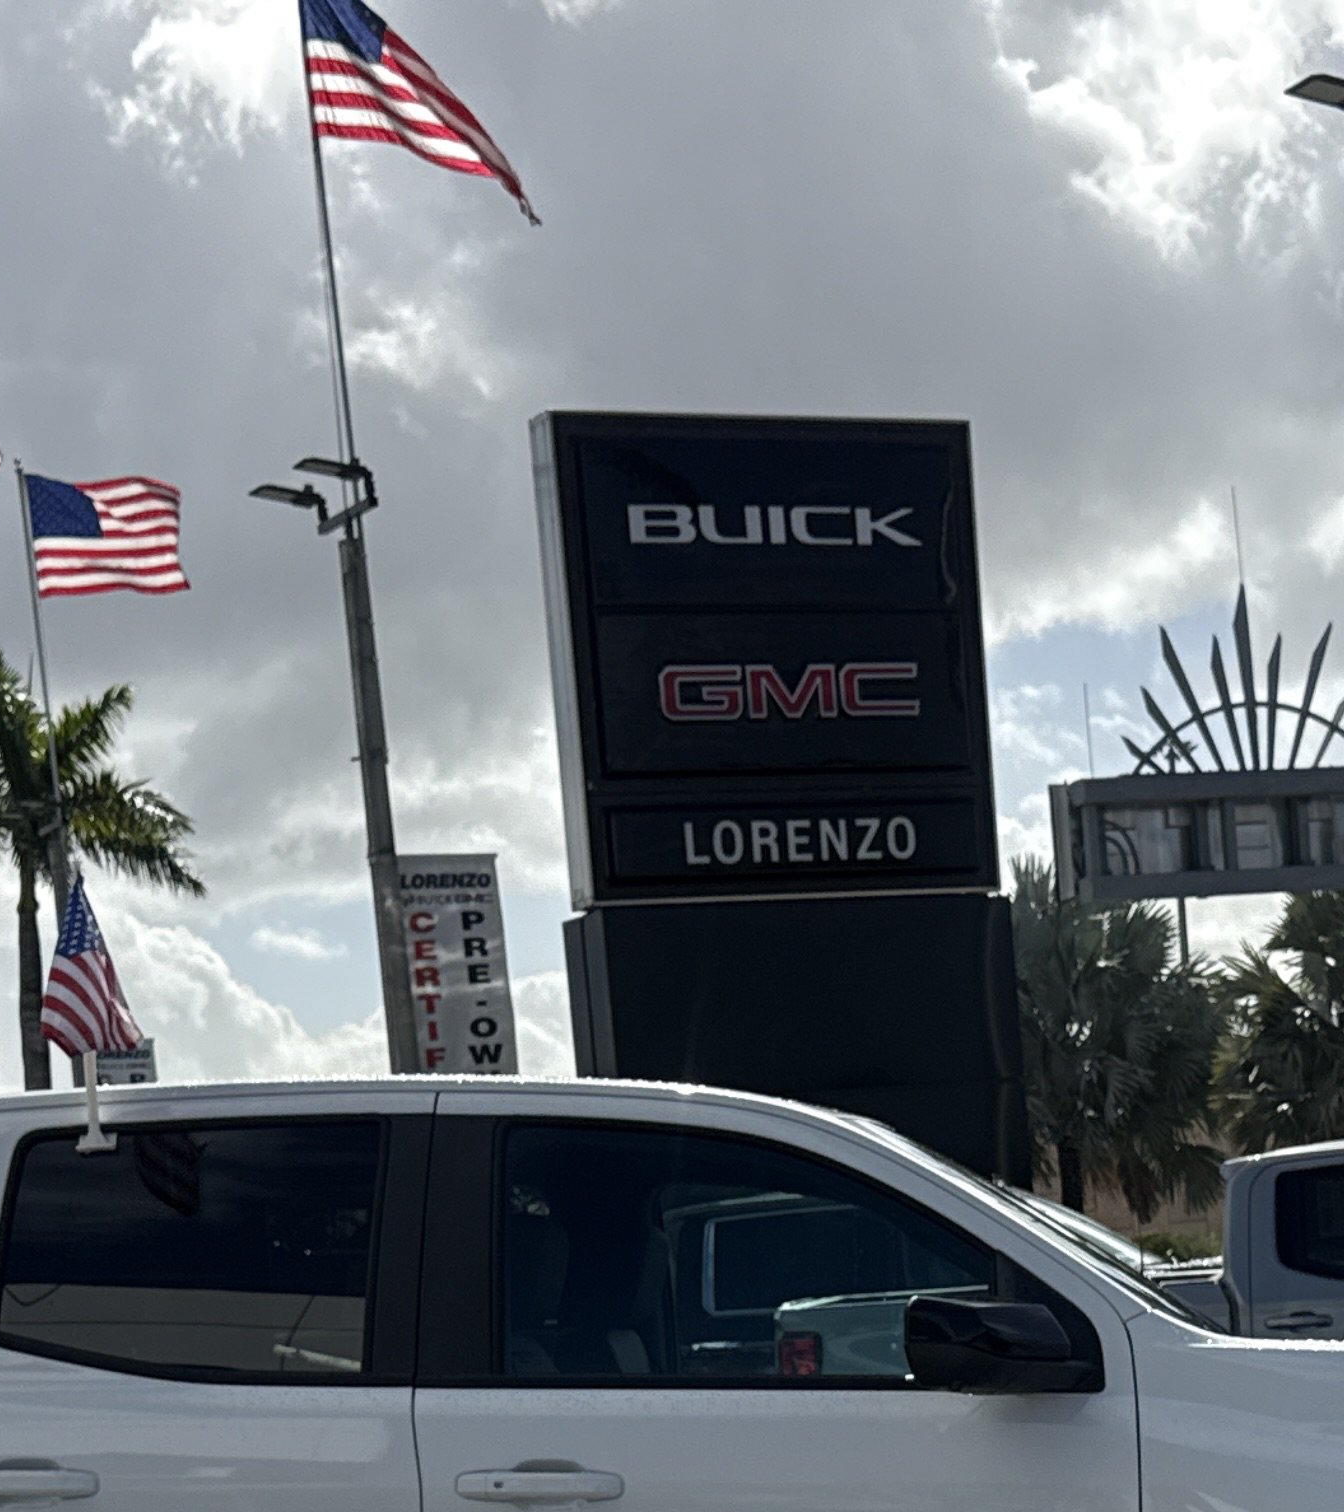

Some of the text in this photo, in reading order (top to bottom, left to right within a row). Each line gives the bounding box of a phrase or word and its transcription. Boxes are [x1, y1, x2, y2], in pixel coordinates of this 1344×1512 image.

[627, 503, 923, 546] BUICK
[658, 662, 920, 721] GMC
[683, 817, 917, 865] LORENZO
[400, 873, 491, 889] LORENZO
[409, 911, 447, 1069] CERTIF
[460, 910, 503, 1066] PRE-OW
